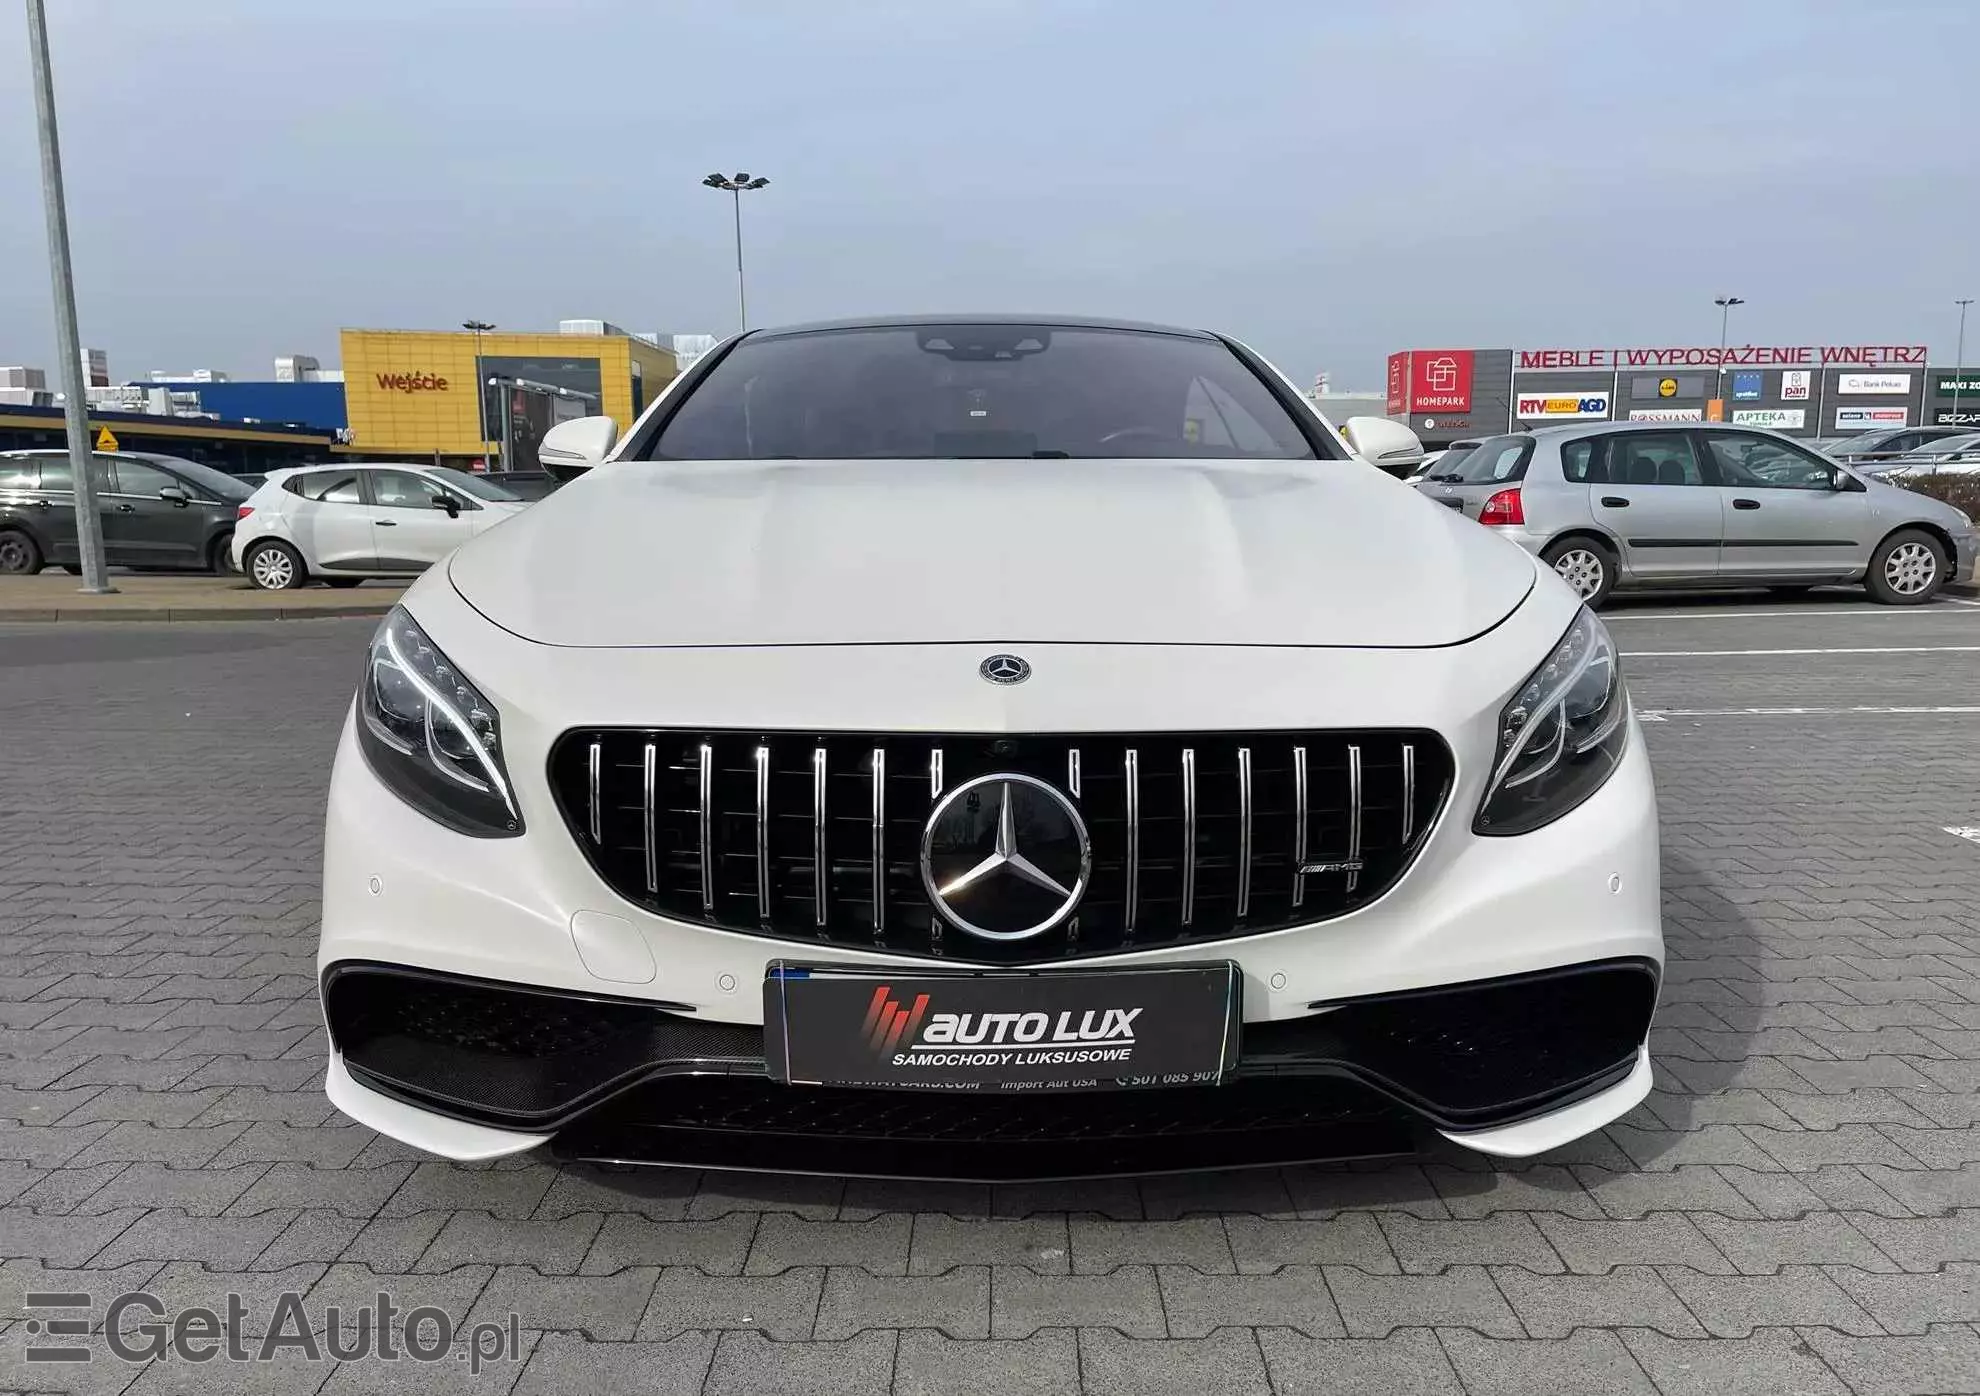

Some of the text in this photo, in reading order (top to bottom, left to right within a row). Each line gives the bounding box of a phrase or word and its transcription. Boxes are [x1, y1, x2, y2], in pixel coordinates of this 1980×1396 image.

[1520, 350, 1604, 368] MEBLE
[1626, 344, 1812, 365] WYPOSAŻENIE
[1821, 346, 1926, 367] WNĘTRZ
[376, 371, 448, 394] Wejście
[1941, 381, 1967, 389] MAXI
[1784, 386, 1806, 398] pan
[1416, 396, 1465, 406] HOMEPARK
[1519, 399, 1607, 414] RTV EURO AGD
[1736, 411, 1786, 421] APTEKA
[1053, 1008, 1144, 1041] LUX
[892, 1049, 1132, 1066] SAMOCHODY LUKSUSOWE
